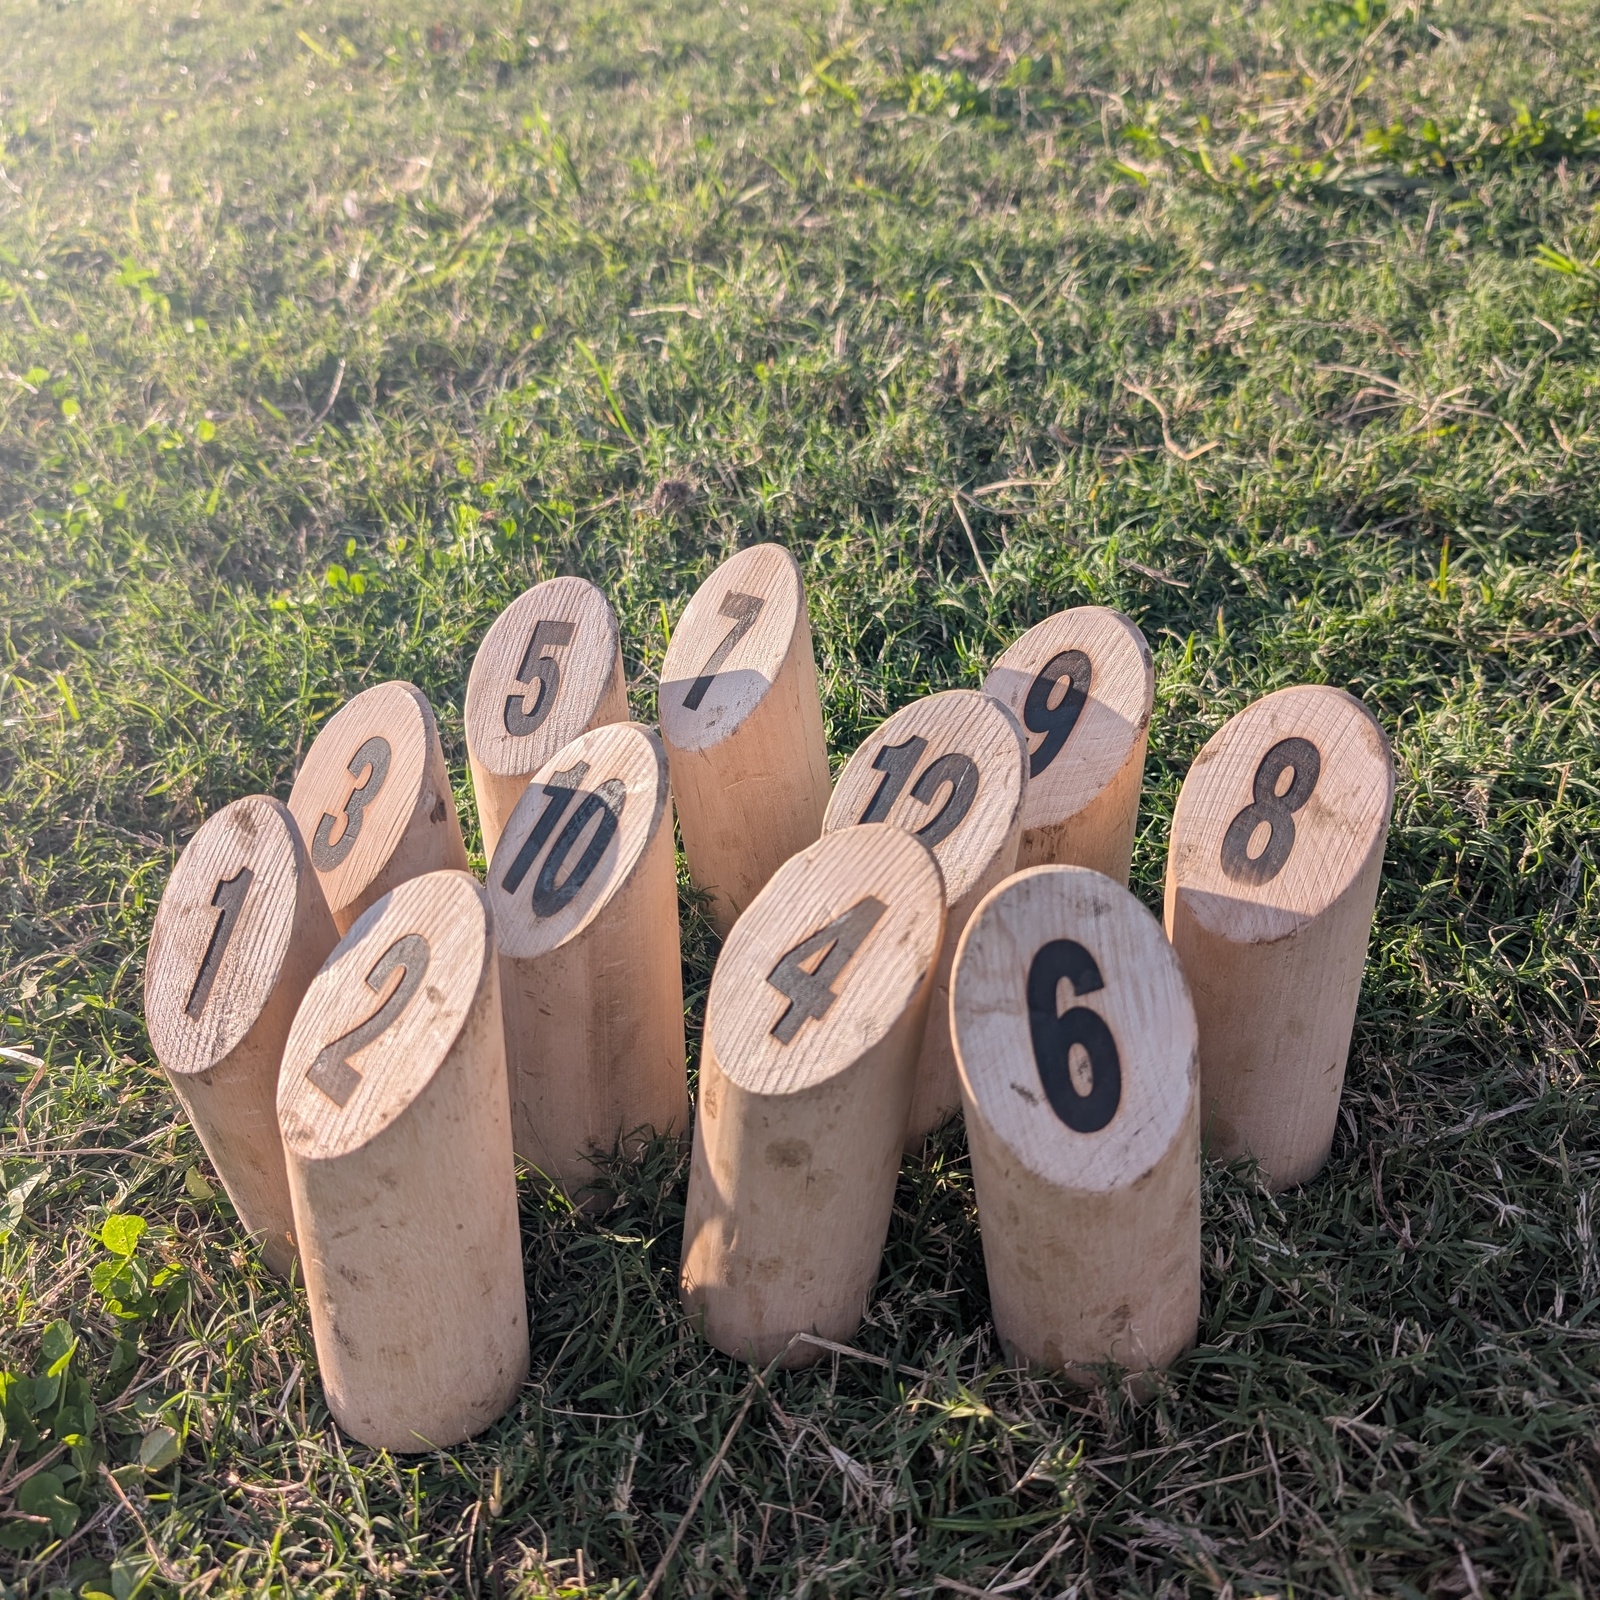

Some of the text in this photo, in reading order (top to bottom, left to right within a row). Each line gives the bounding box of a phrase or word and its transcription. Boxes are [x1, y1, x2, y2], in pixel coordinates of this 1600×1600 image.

[504, 620, 576, 736] 5
[683, 590, 765, 710] 7
[1023, 649, 1092, 778] 9
[312, 736, 392, 873] 3
[502, 761, 627, 918] 10
[859, 735, 980, 847] 12
[1220, 736, 1321, 886] 8
[185, 866, 255, 1022] 1
[766, 894, 889, 1045] 4
[306, 933, 431, 1109] 2
[1027, 938, 1122, 1133] 6
